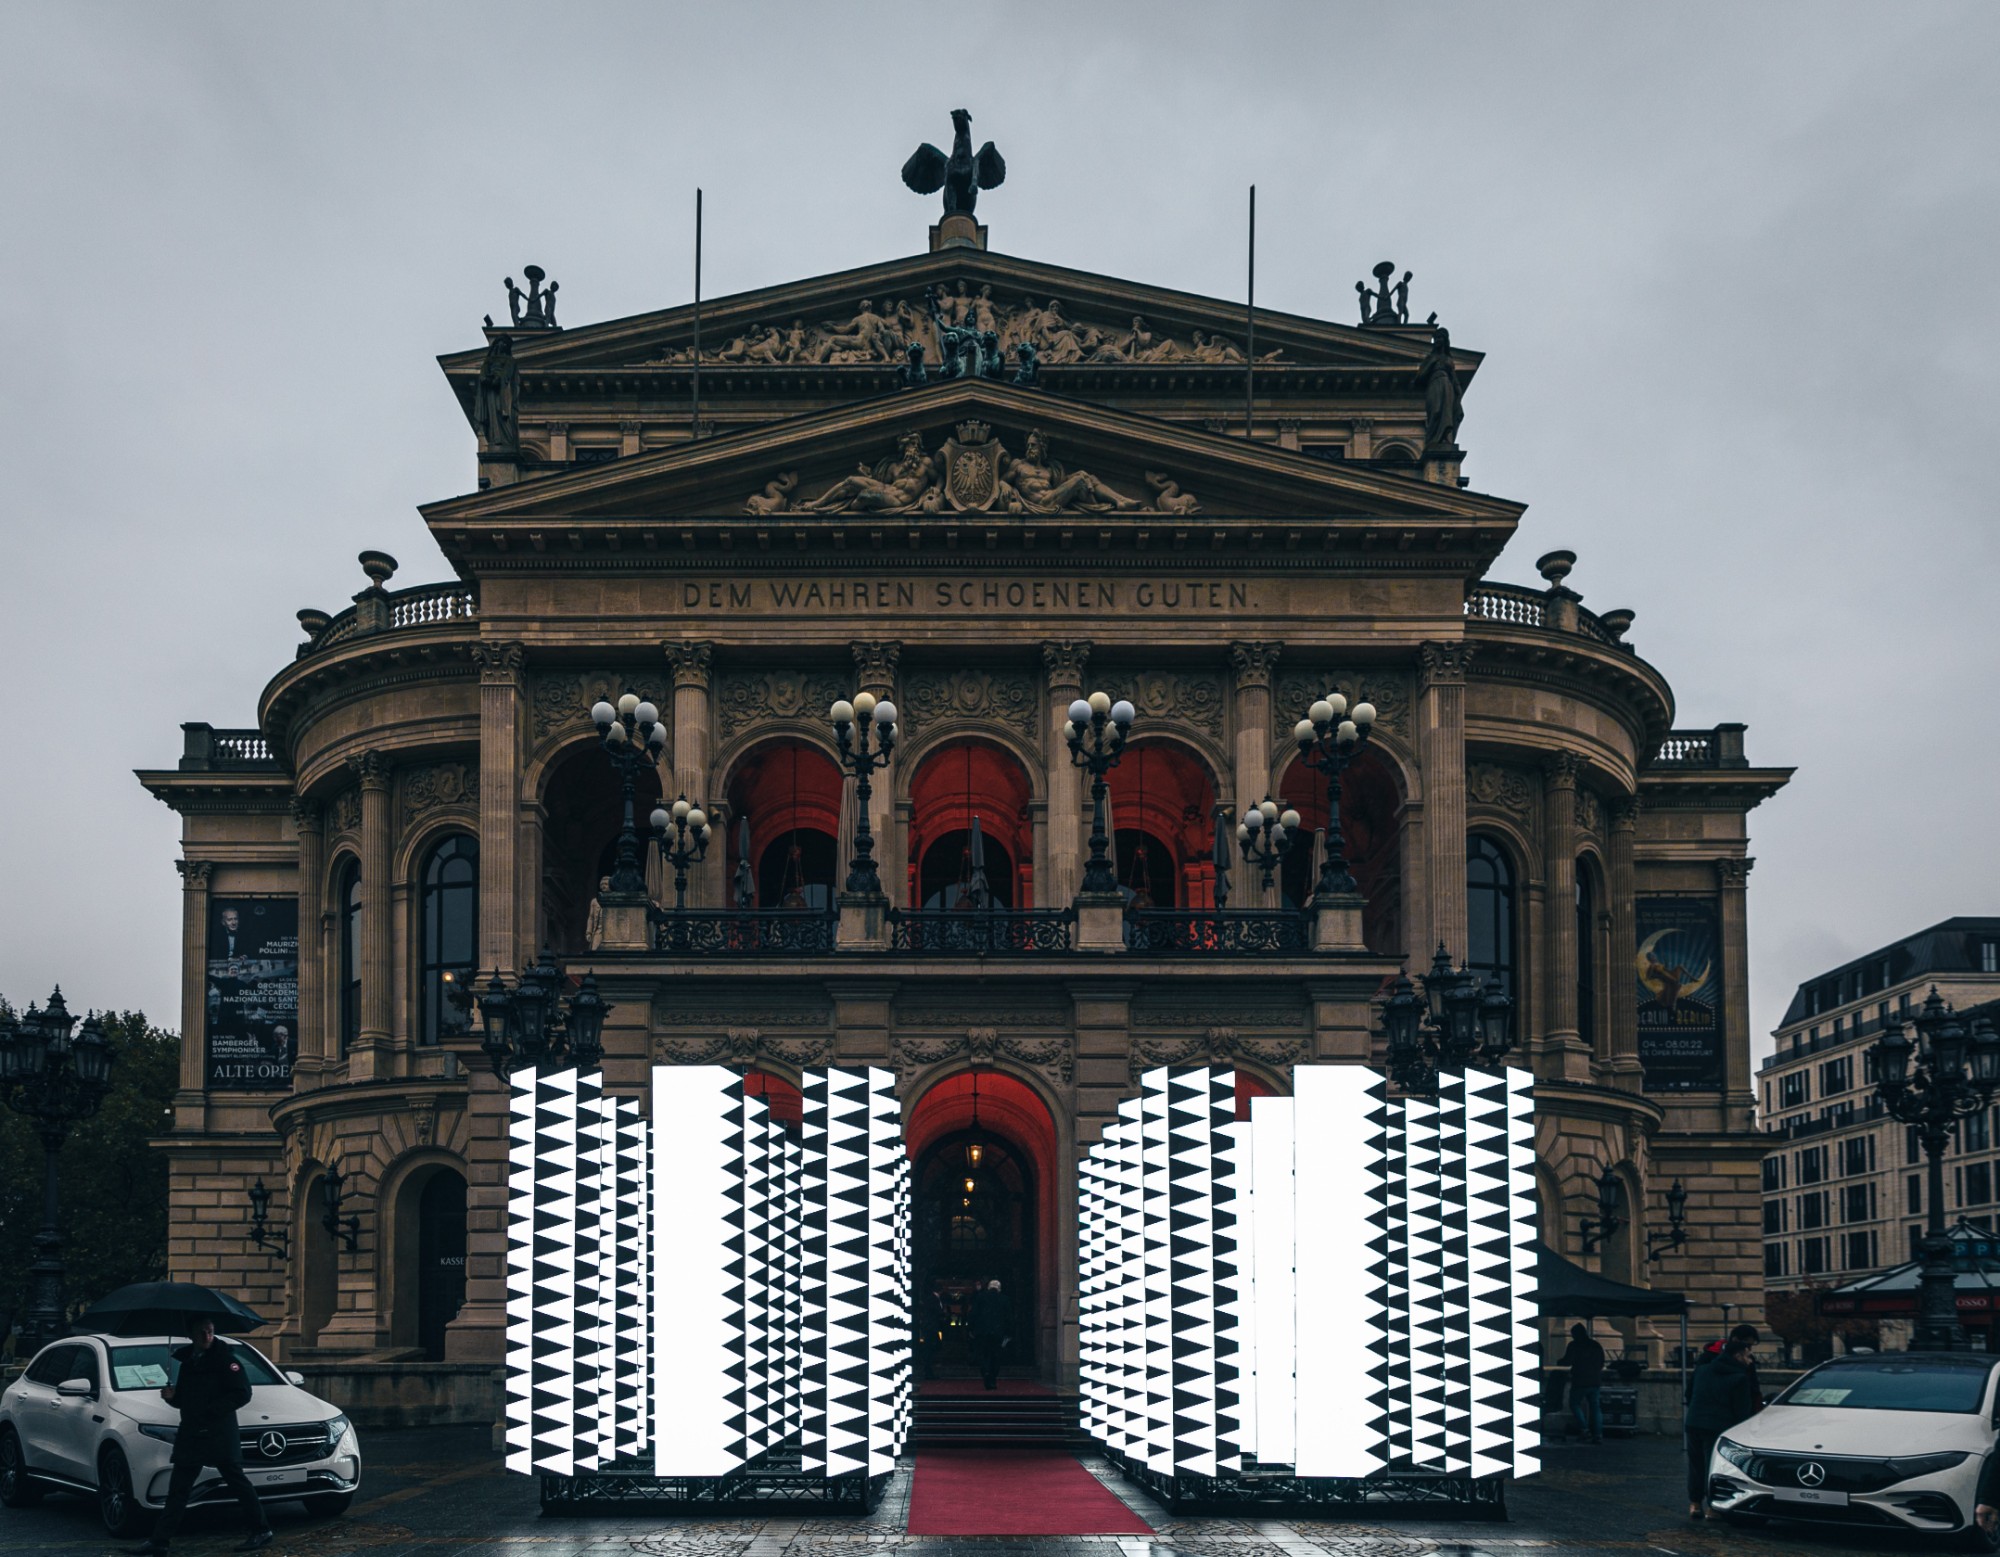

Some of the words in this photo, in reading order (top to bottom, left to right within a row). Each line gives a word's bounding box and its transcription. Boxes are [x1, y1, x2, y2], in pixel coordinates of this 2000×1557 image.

[684, 583, 751, 607] DEM
[770, 582, 914, 607] WAHREN
[935, 582, 1116, 607] SCHOENEN
[1136, 582, 1259, 607] GUTEN.
[213, 1064, 255, 1078] ALTE
[257, 1064, 291, 1078] OPE
[1977, 1244, 1988, 1256] P
[440, 1256, 465, 1266] KASSE
[266, 1474, 285, 1482] EQC
